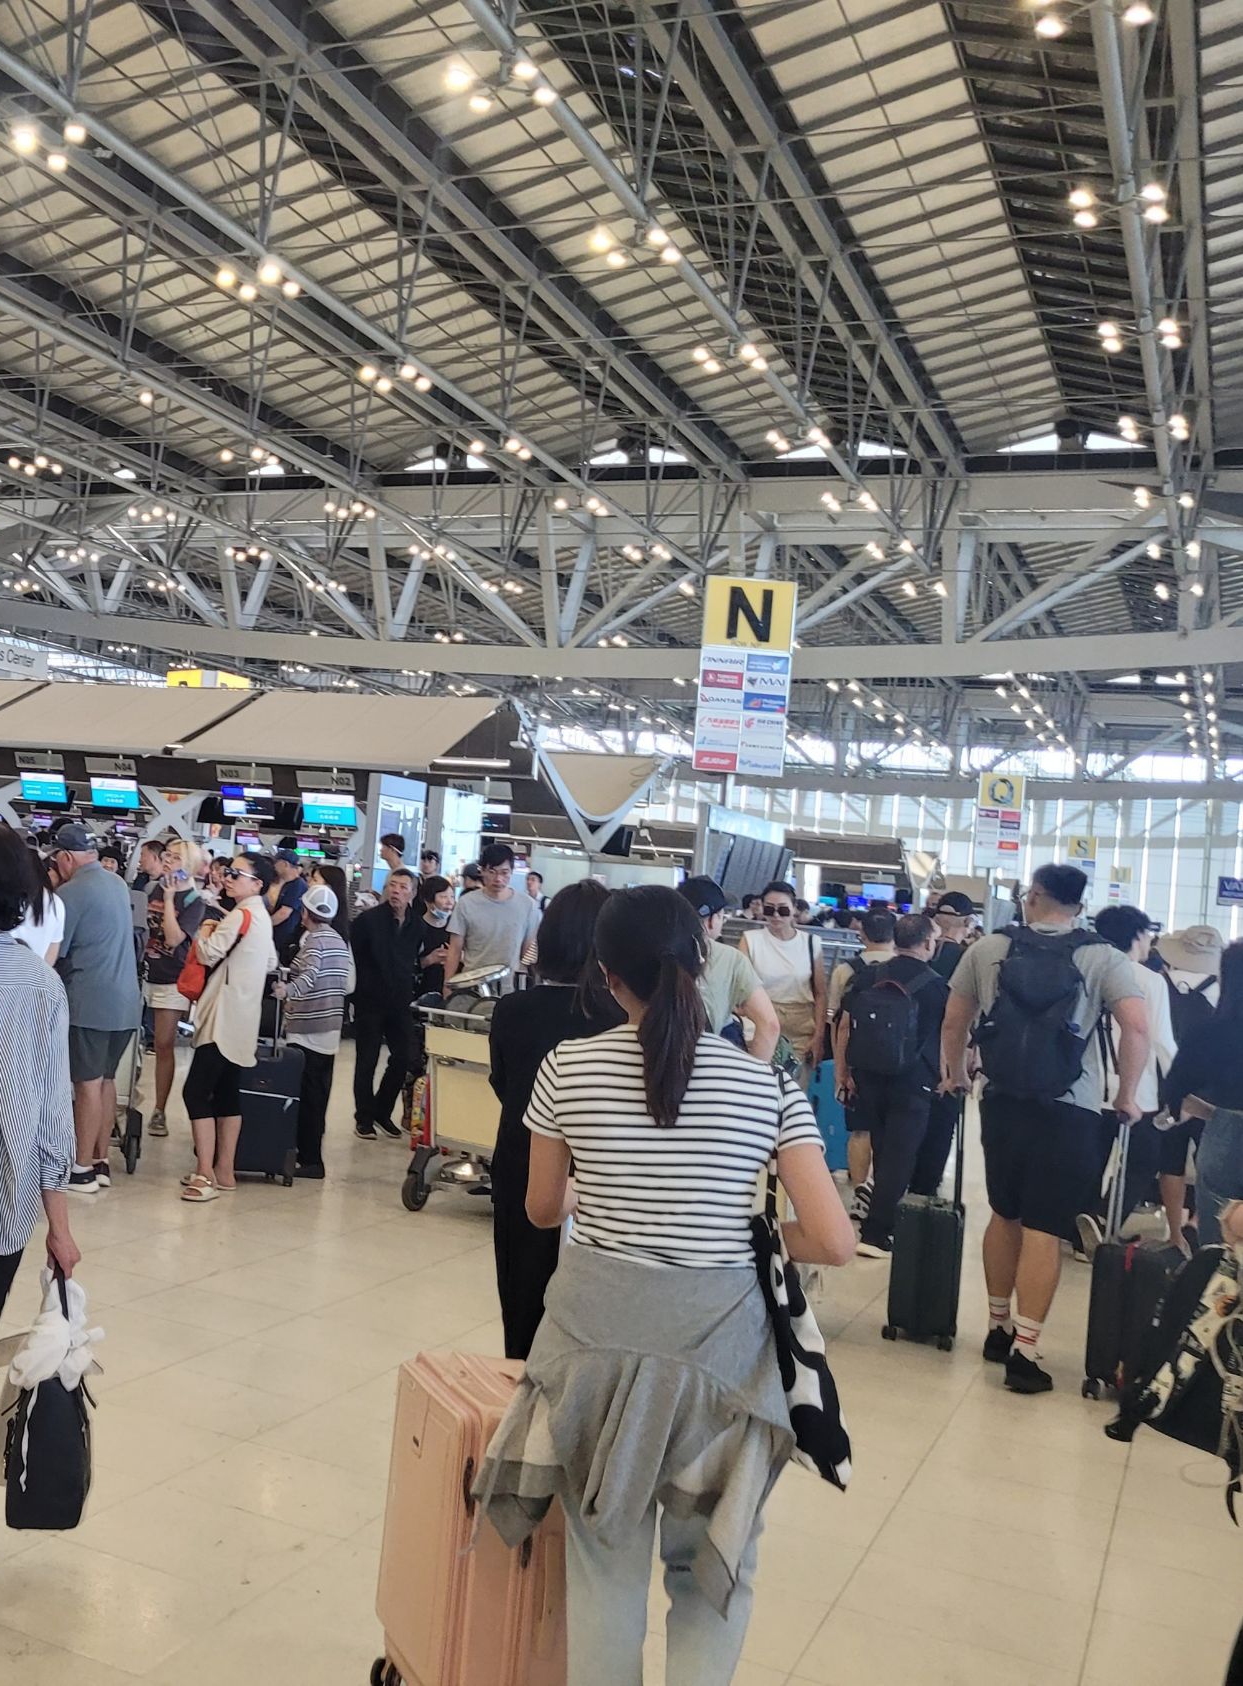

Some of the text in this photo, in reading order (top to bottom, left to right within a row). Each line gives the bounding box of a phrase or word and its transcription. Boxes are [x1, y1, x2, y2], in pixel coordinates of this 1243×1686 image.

[726, 586, 773, 642] N
[7, 648, 35, 668] Center
[708, 696, 742, 705] QANTAS
[220, 768, 240, 778] N03
[331, 776, 352, 786] N02
[989, 779, 1014, 804] Q
[1075, 839, 1089, 856] S
